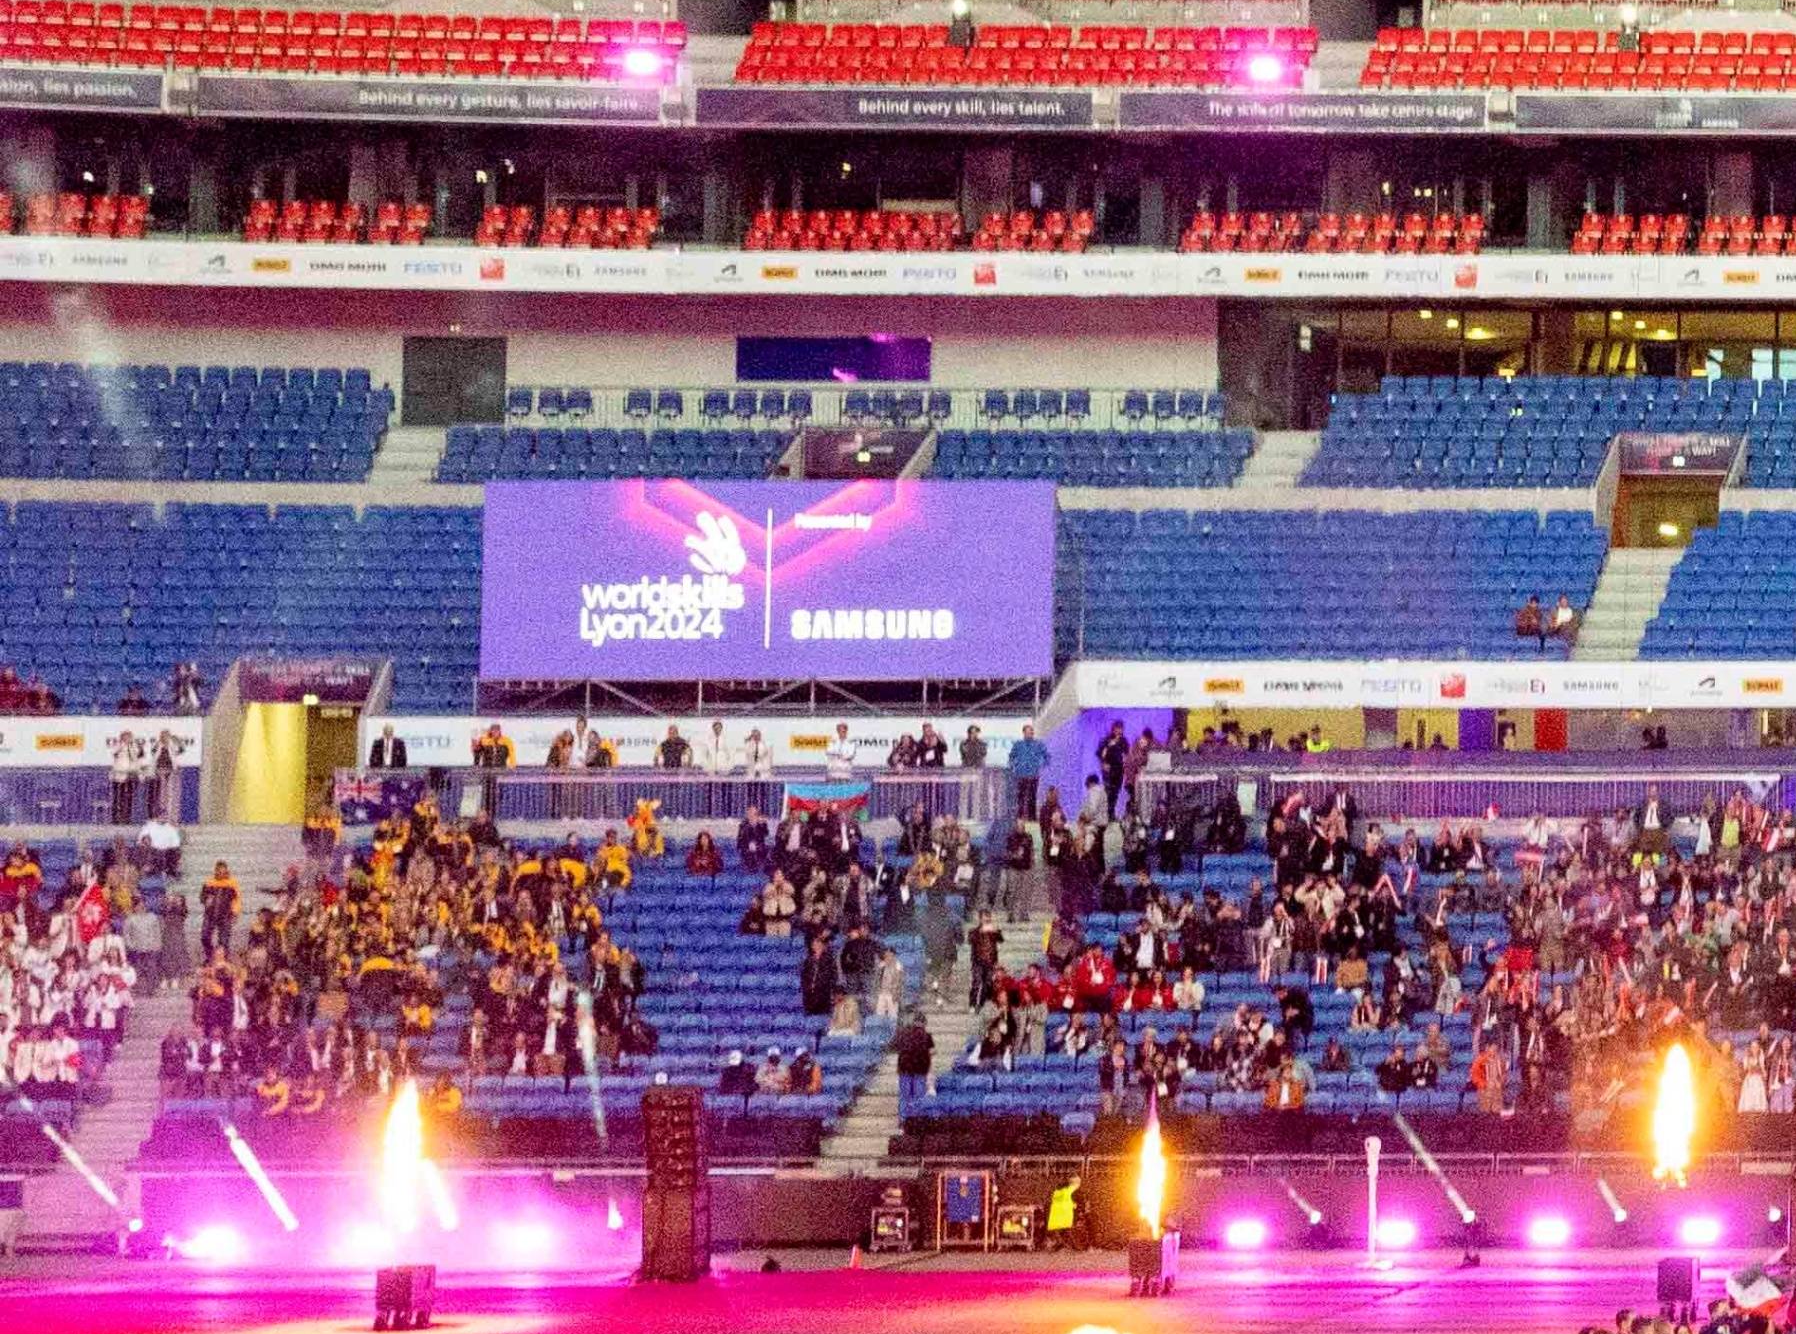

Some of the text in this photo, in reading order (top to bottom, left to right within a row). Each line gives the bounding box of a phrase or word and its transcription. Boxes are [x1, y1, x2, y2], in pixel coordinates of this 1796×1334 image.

[860, 100, 1064, 118] Behind every skill, lies talent.
[582, 574, 744, 610] worldskills
[579, 608, 723, 648] Lyon2024
[790, 609, 954, 640] SAMSUNG
